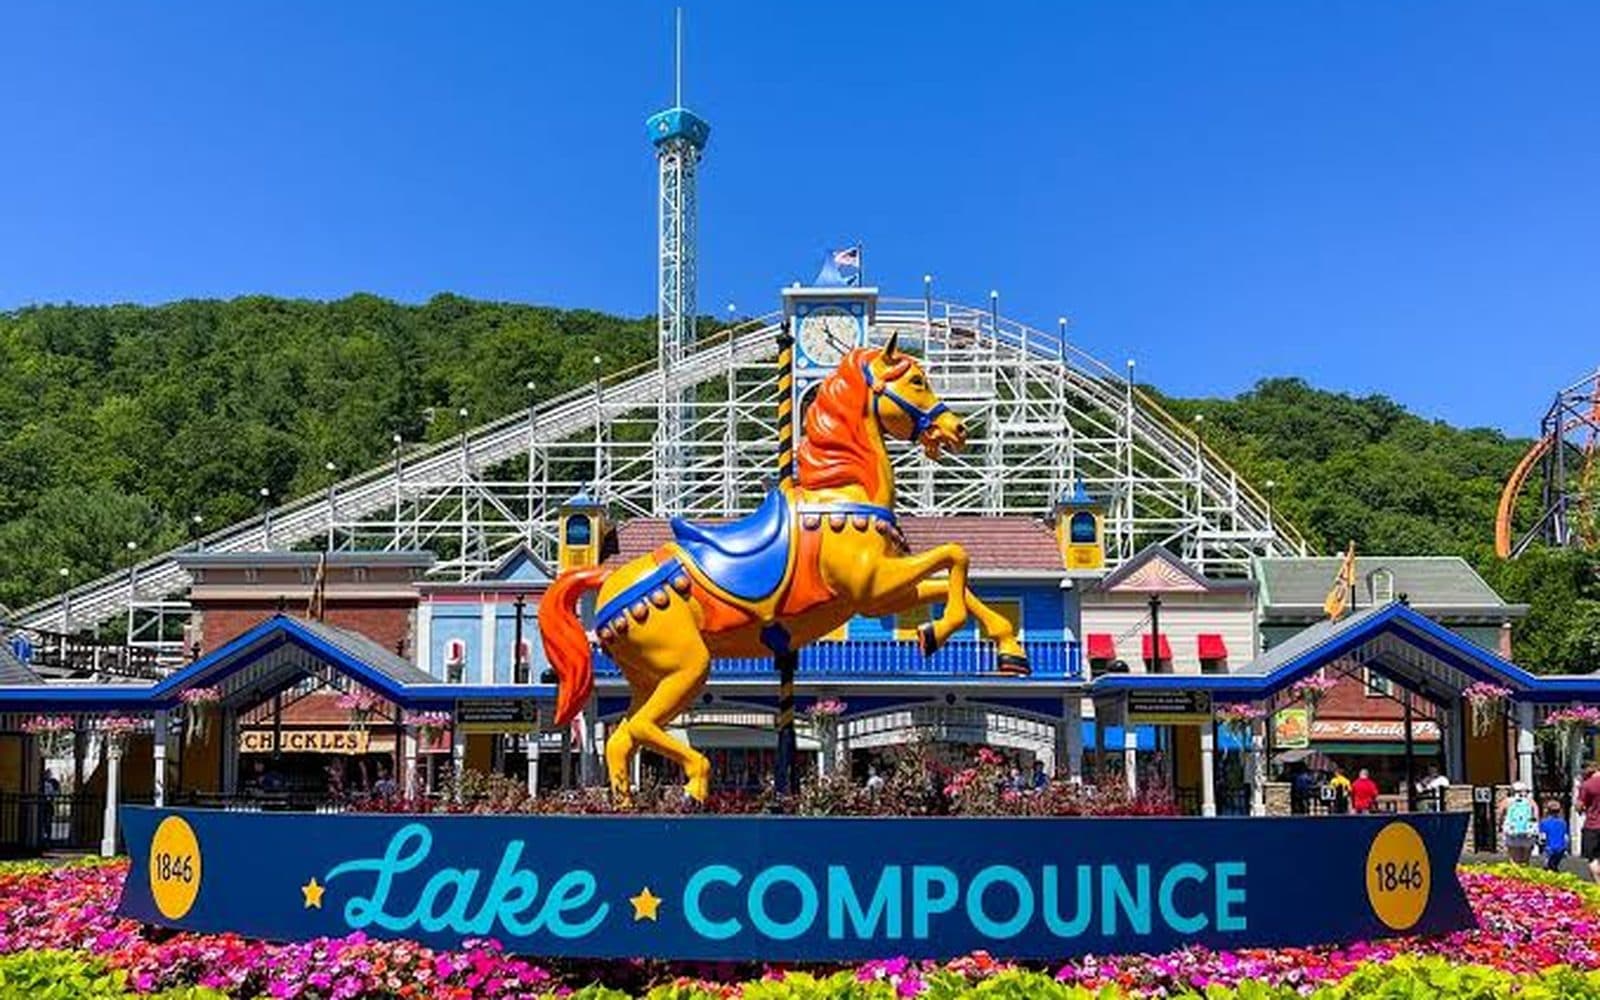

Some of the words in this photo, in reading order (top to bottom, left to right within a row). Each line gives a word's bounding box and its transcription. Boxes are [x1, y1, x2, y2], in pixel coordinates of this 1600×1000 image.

[1343, 720, 1406, 736] Potato
[155, 853, 192, 883] 1846
[325, 823, 609, 939] Lake
[684, 862, 1247, 940] COMPOUNCE
[1375, 861, 1424, 892] 1846
